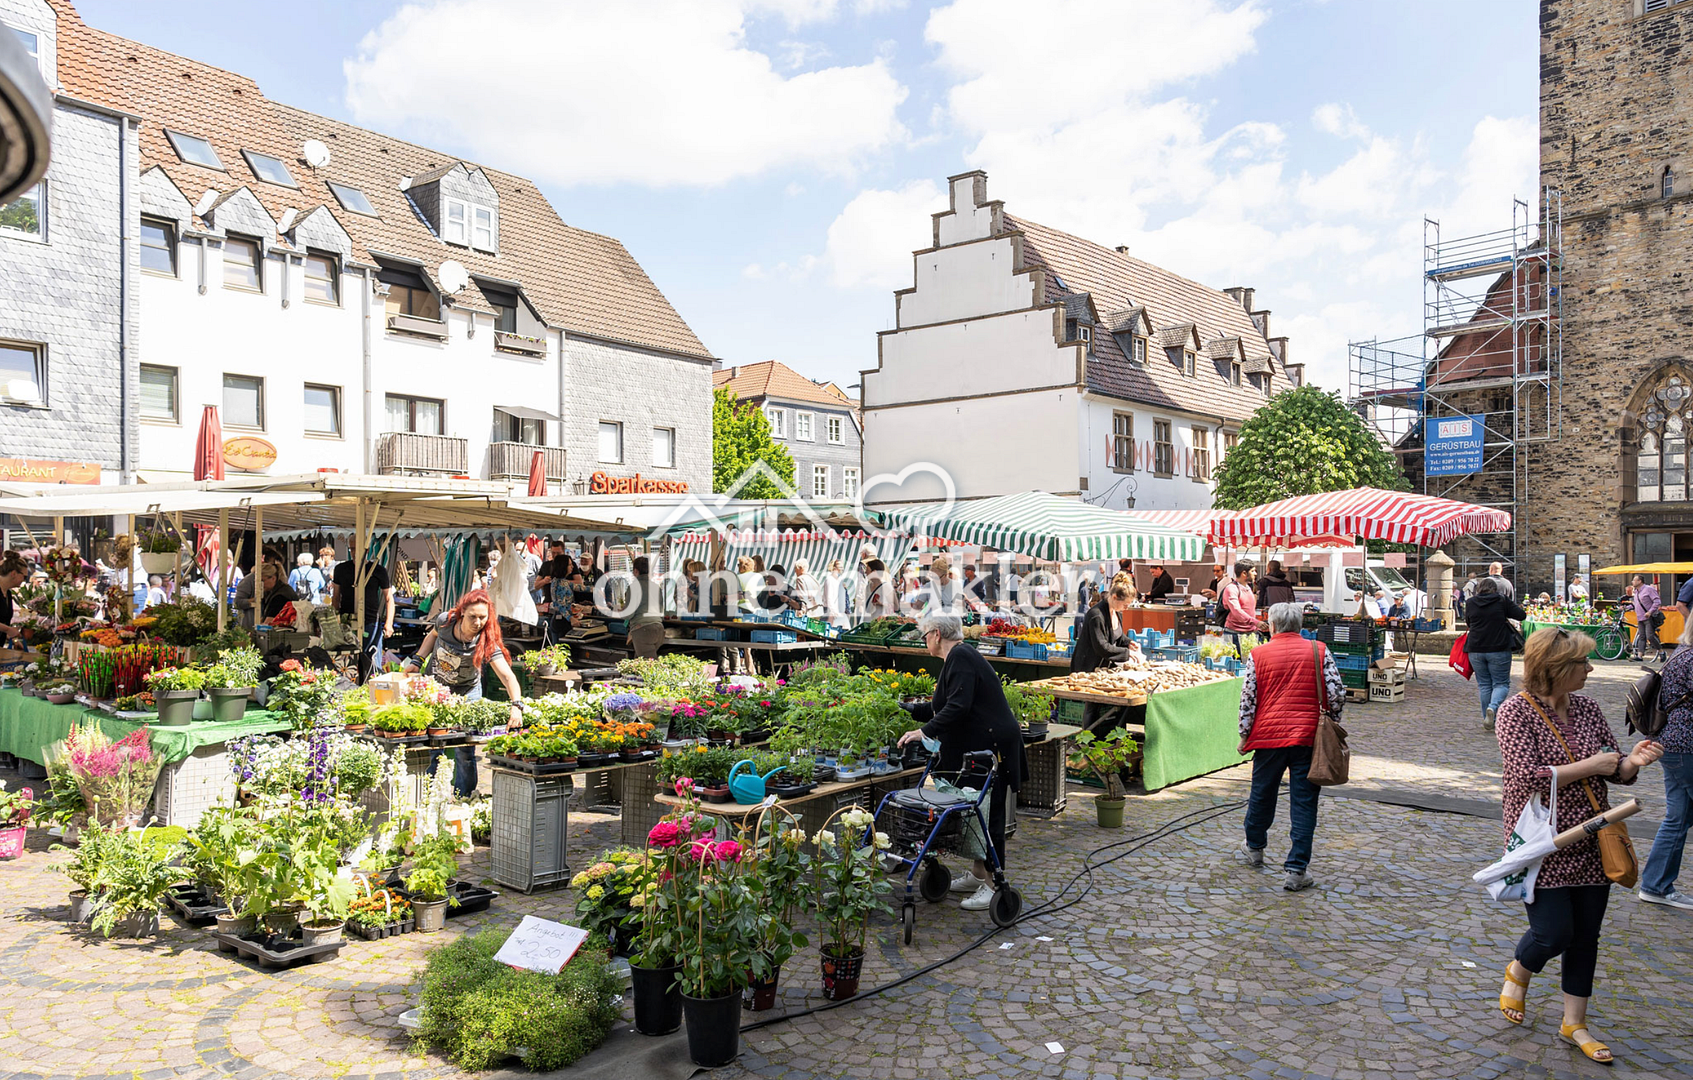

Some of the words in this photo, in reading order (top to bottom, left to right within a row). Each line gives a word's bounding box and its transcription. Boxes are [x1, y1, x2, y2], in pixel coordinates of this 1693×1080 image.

[1429, 440, 1481, 451] GERÜSTBAU
[591, 471, 689, 494] Sparkasse
[1372, 672, 1388, 680] UNO
[1371, 687, 1391, 697] UNO
[526, 923, 566, 939] Angebot
